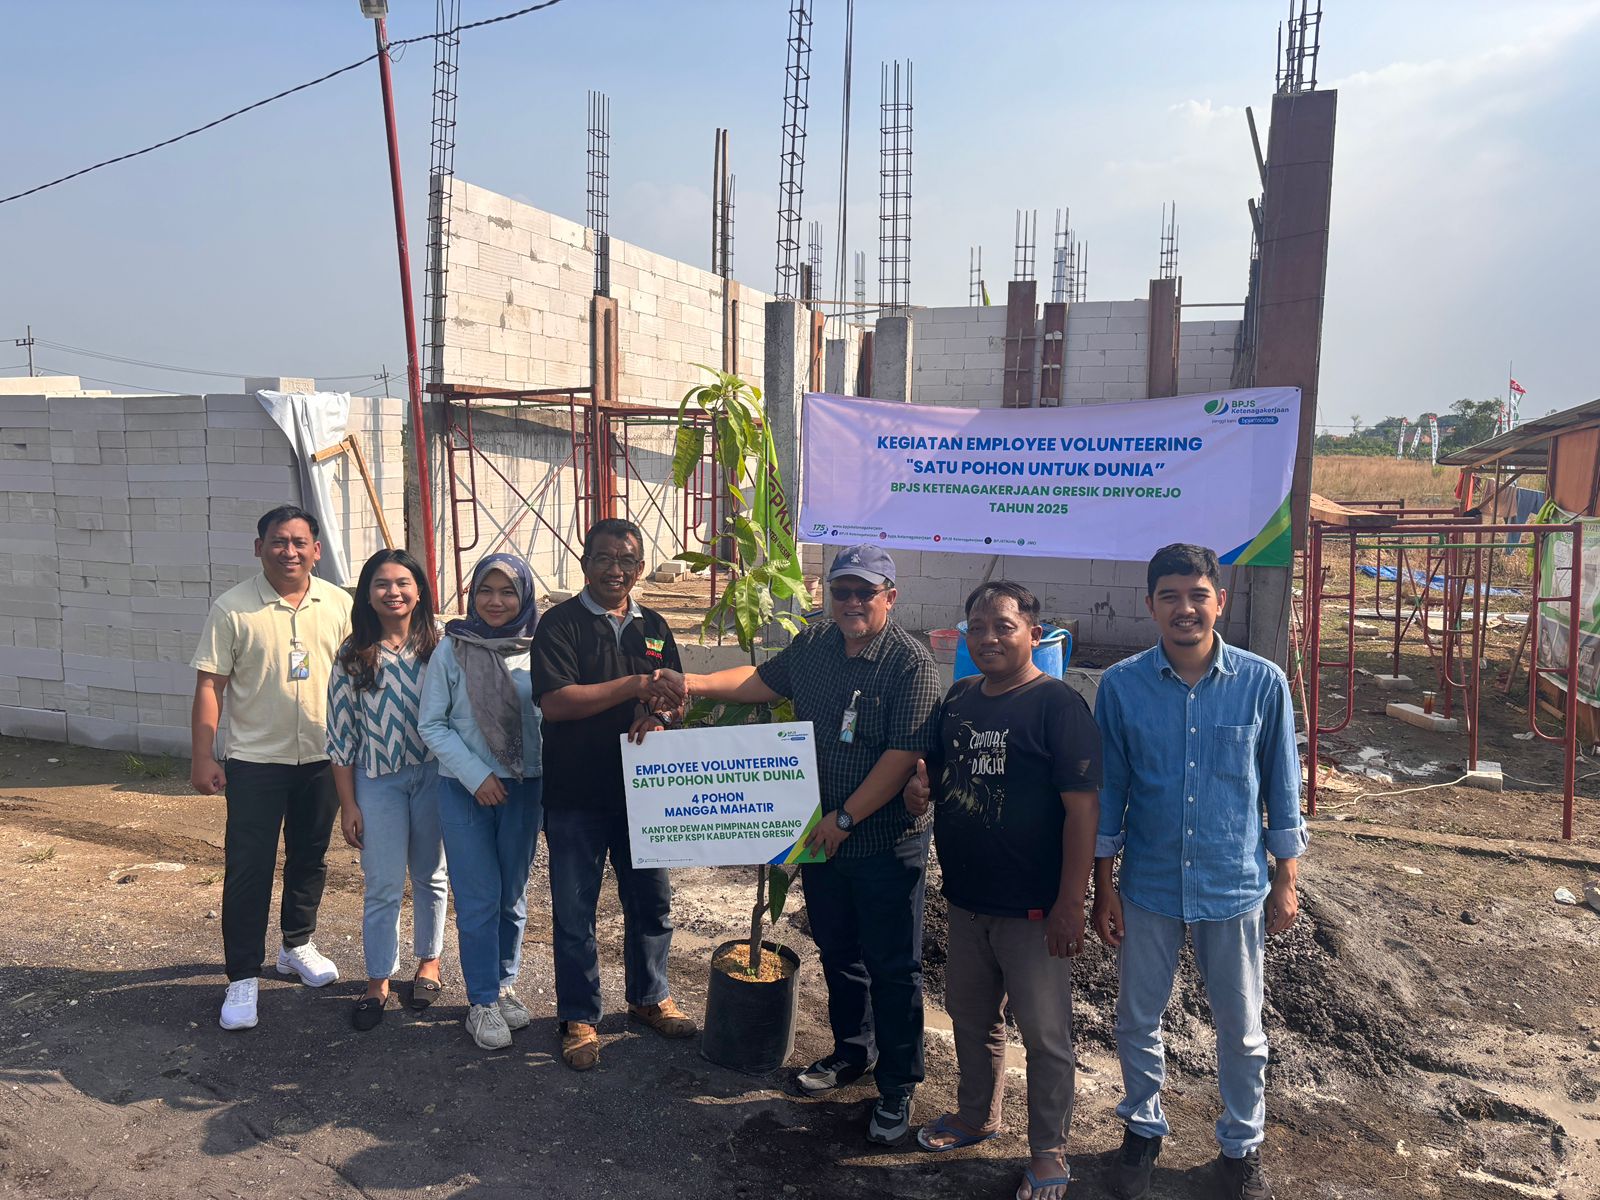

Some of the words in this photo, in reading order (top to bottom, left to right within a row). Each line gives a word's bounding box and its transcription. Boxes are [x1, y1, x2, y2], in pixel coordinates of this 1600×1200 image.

[1231, 400, 1256, 408] BPJS
[1231, 407, 1290, 415] Ketenagakerjaan
[877, 436, 963, 450] KEGIATAN
[966, 437, 1057, 451] EMPLOYEE
[1060, 437, 1203, 451] VOLUNTEERING
[961, 461, 1025, 475] POHON
[1028, 462, 1090, 476] UNTUK
[890, 482, 921, 493] BPJS
[923, 483, 1050, 496] KETENAGAKERJAAN
[1052, 486, 1100, 497] GRESIK
[1102, 487, 1182, 498] DRIYOREJO
[989, 502, 1035, 514] TAHUN
[1036, 503, 1069, 515] 2025
[635, 761, 699, 776] EMPLOYEE
[701, 756, 799, 772] VOLUNTEERING
[632, 776, 665, 788] SATU
[667, 774, 714, 787] POHON
[717, 771, 760, 784] UNTUK
[763, 769, 806, 782] DUNIA
[691, 794, 699, 804] 4
[702, 791, 745, 804] POHON
[664, 804, 718, 817] MANGGA
[720, 802, 774, 815] MAHATIR
[641, 825, 679, 835] KANTOR
[679, 823, 714, 833] DEWAN
[715, 821, 760, 832] PIMPINAN
[761, 819, 803, 830] CABANG
[650, 833, 666, 843] FSP
[667, 833, 684, 843] KEP
[685, 832, 705, 842] KSPI
[706, 830, 761, 841] KABUPATEN
[762, 828, 795, 839] GRESIK
